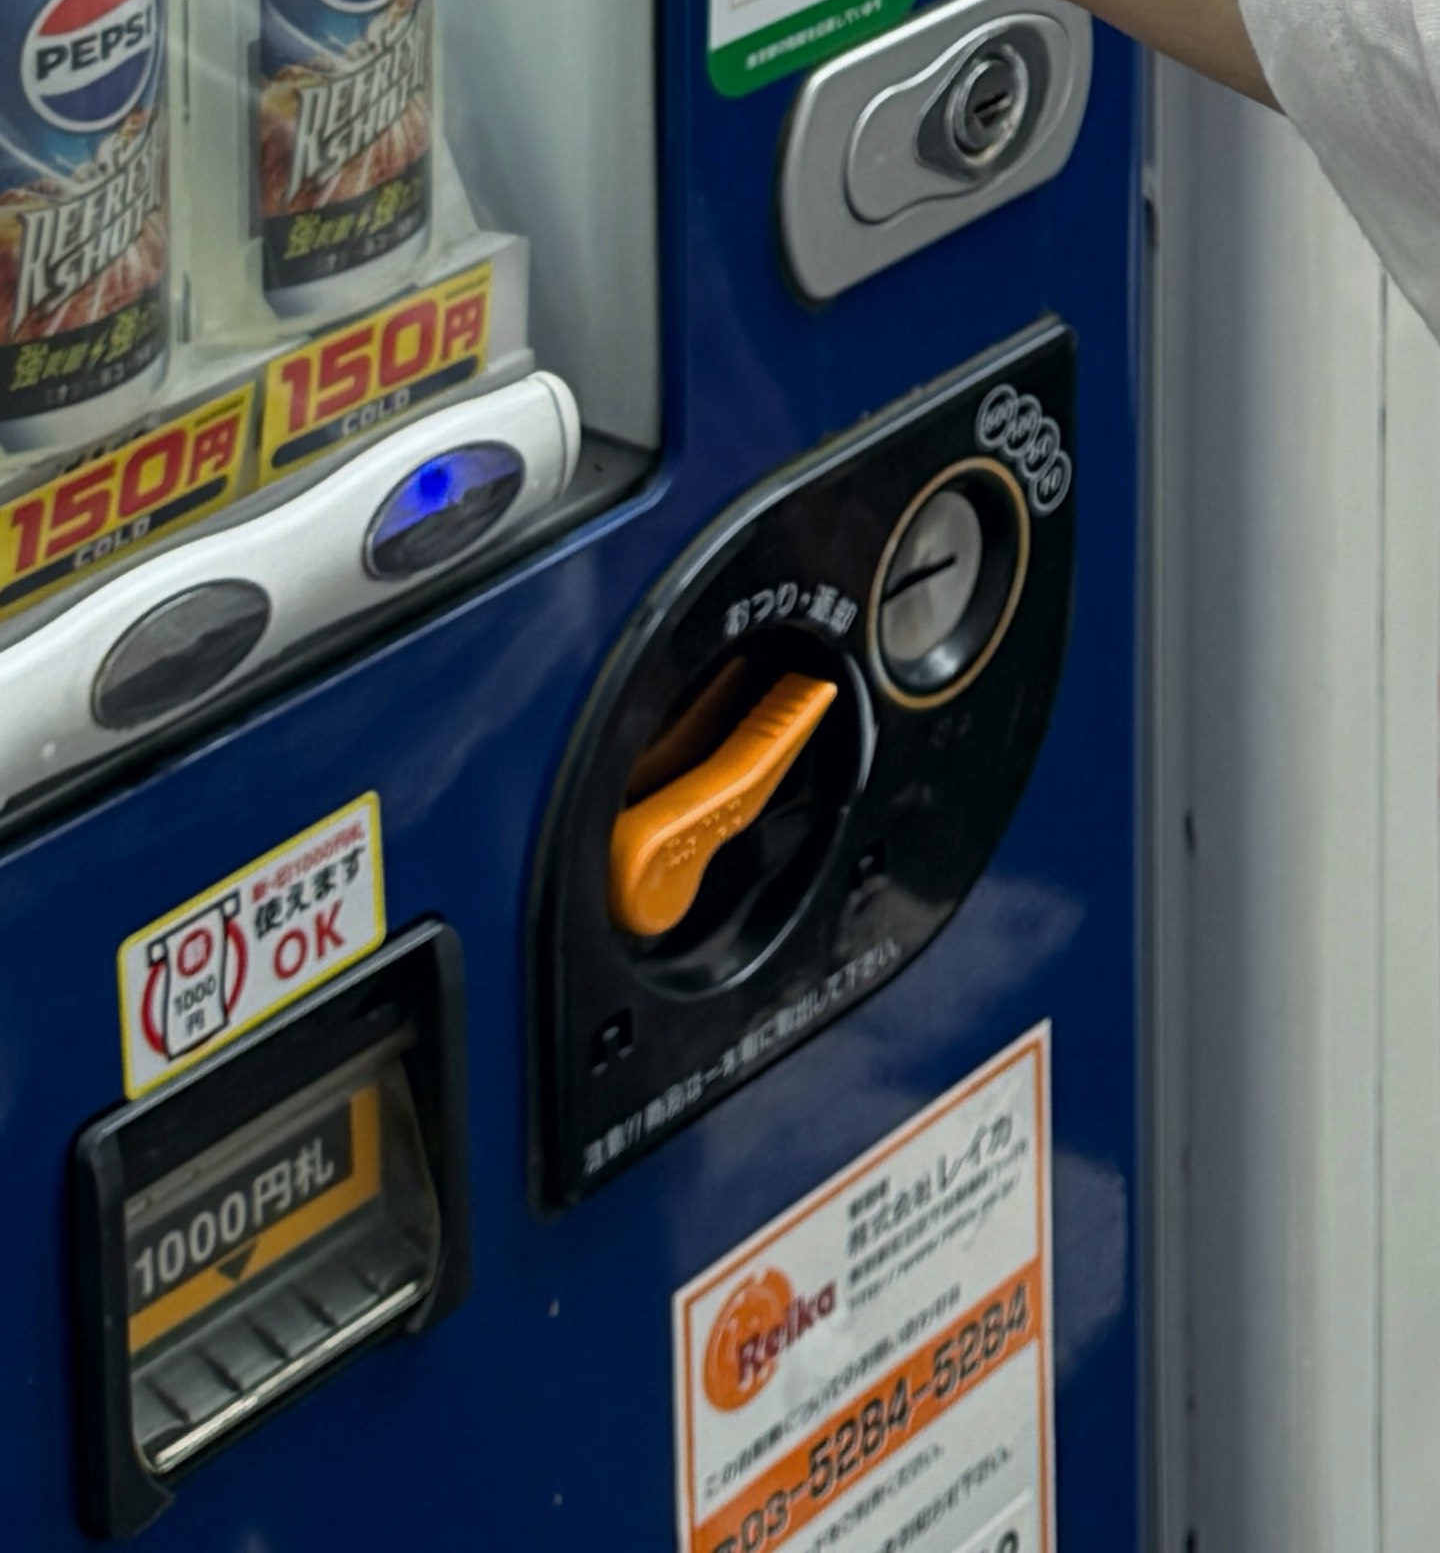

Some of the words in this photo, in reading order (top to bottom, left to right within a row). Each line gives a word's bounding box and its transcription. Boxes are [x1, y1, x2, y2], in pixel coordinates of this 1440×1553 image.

[35, 10, 152, 84] PEPSI
[281, 289, 488, 434] 150円
[340, 387, 411, 437] COLD
[10, 408, 244, 575] 150円
[73, 515, 151, 570] COLD
[255, 844, 366, 941] 使えます
[272, 898, 346, 981] OK
[133, 1135, 335, 1296] 1000円札
